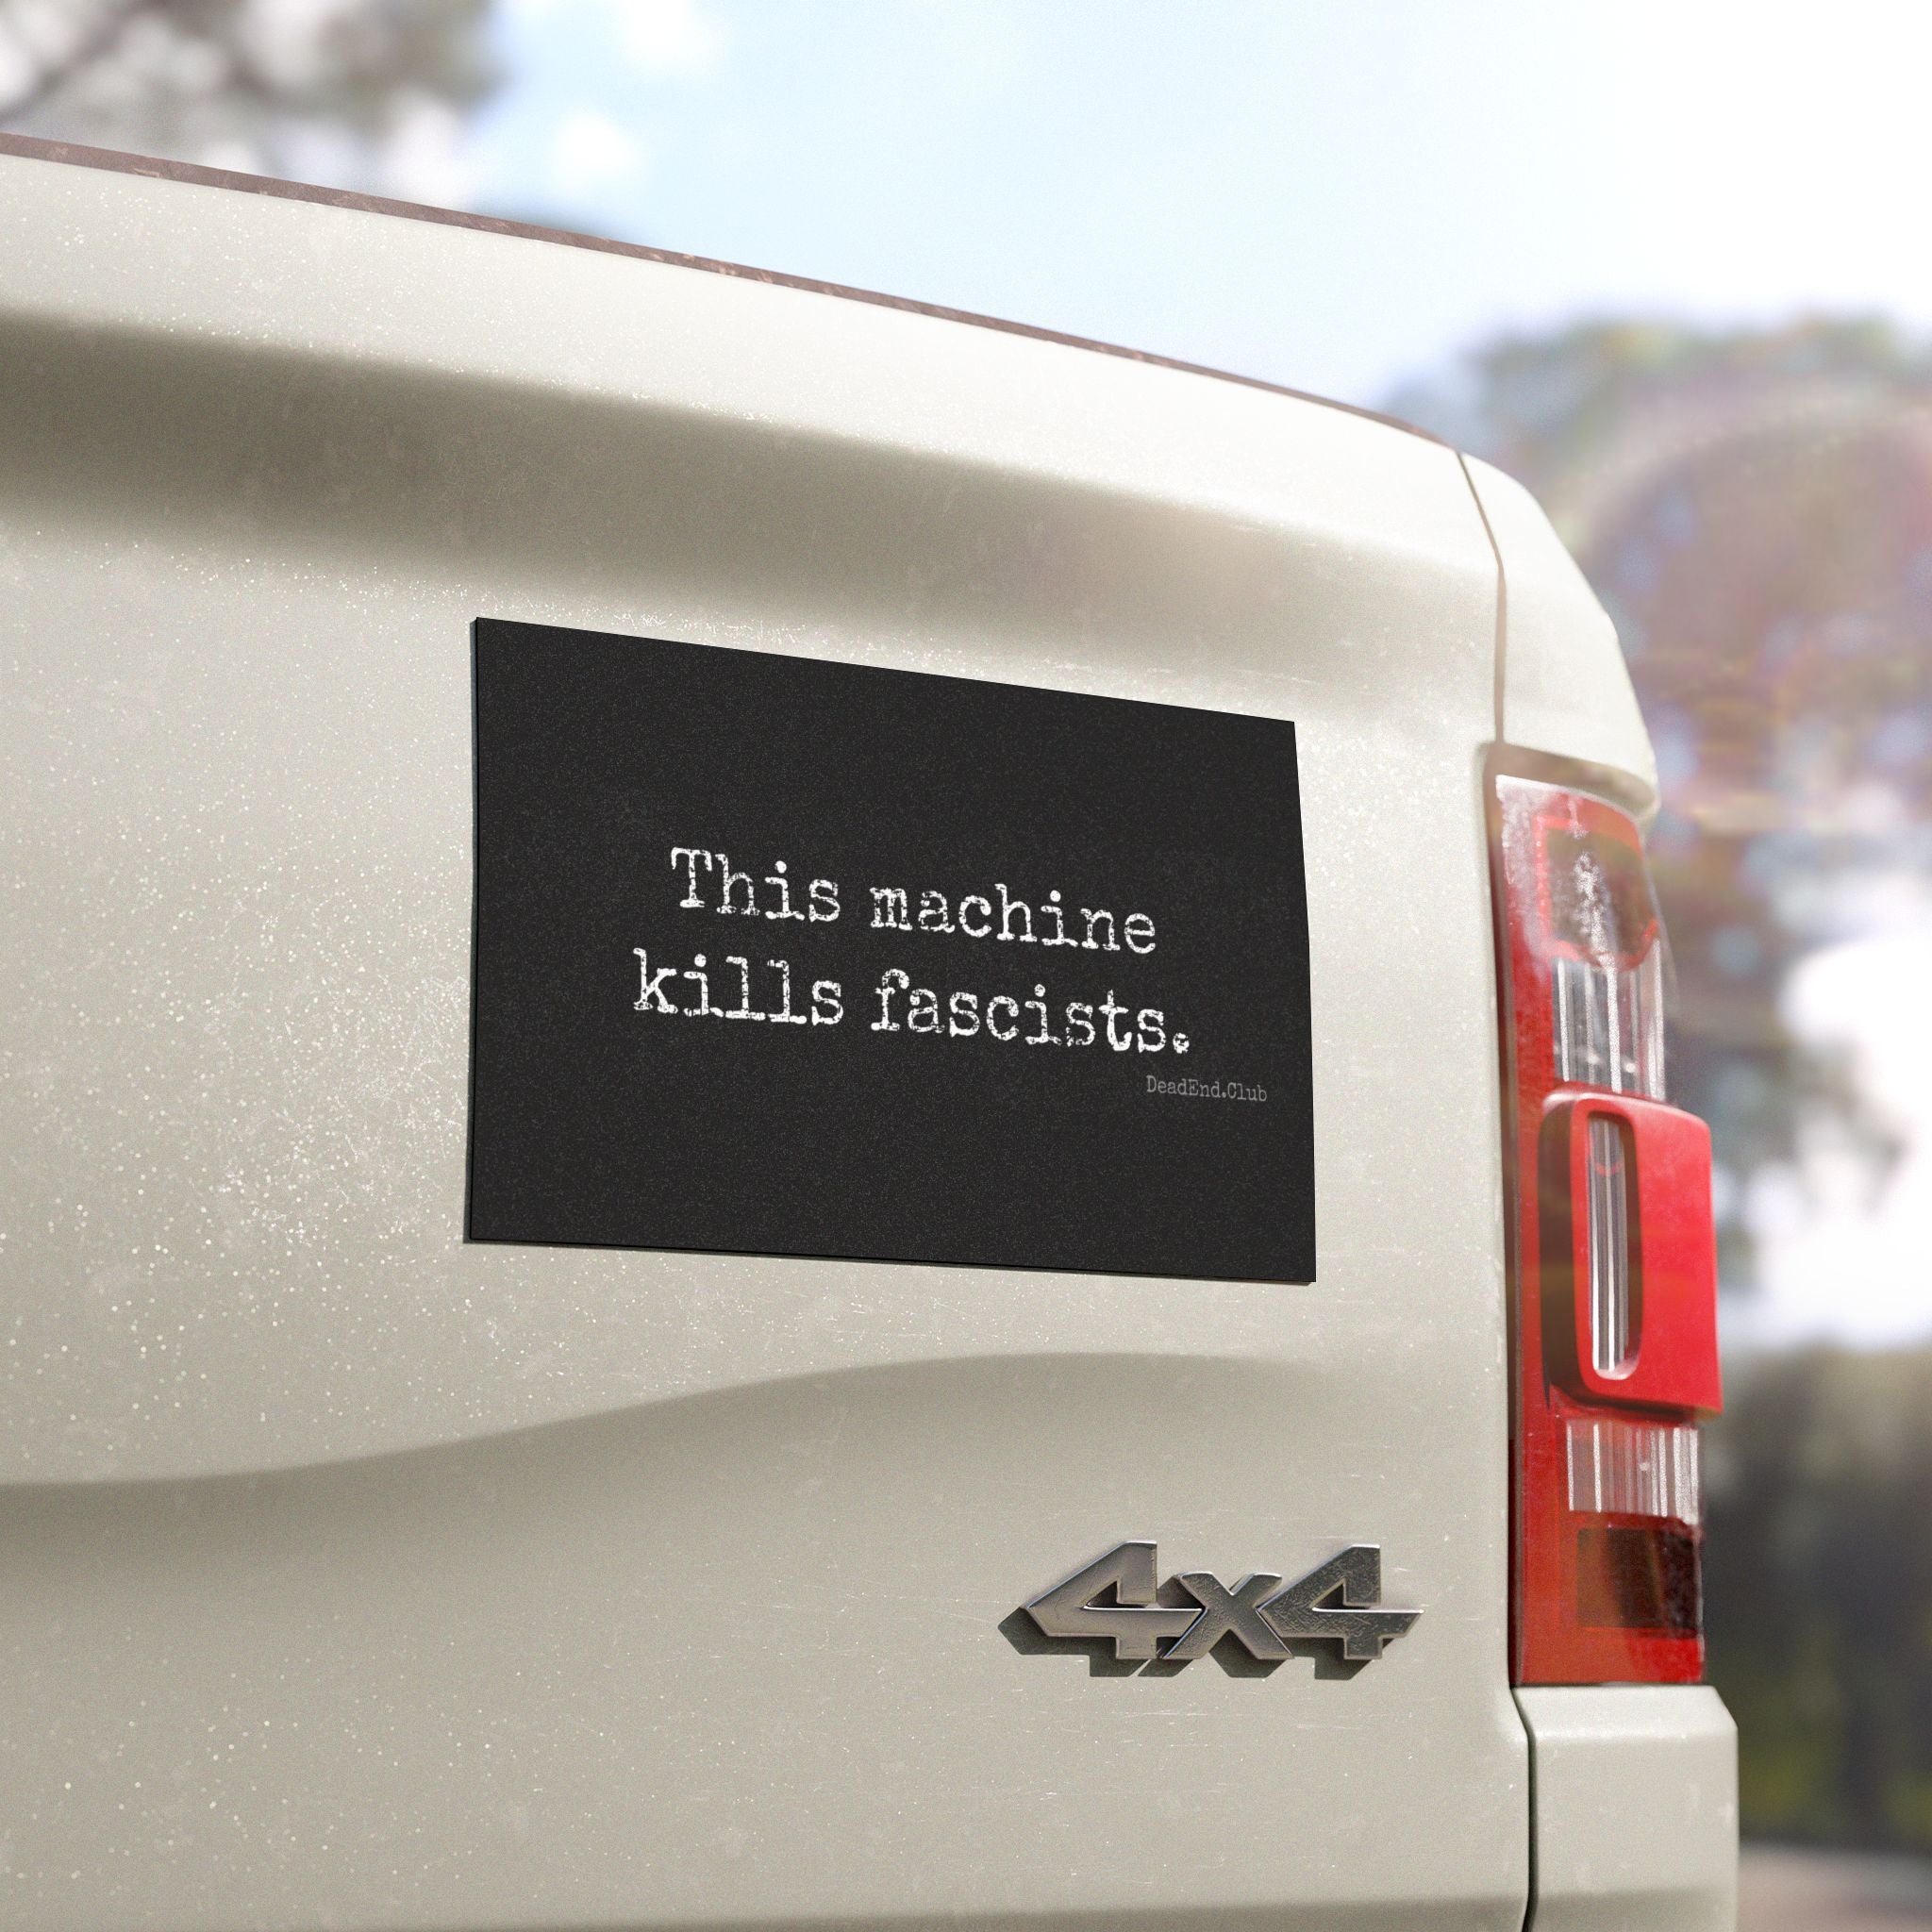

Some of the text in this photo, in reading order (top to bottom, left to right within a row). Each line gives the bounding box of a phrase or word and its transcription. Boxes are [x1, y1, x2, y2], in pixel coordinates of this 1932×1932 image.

[670, 846, 1158, 956] This machine
[632, 947, 1191, 1056] kills fascists.
[1145, 1074, 1268, 1103] DeadEnd.Club
